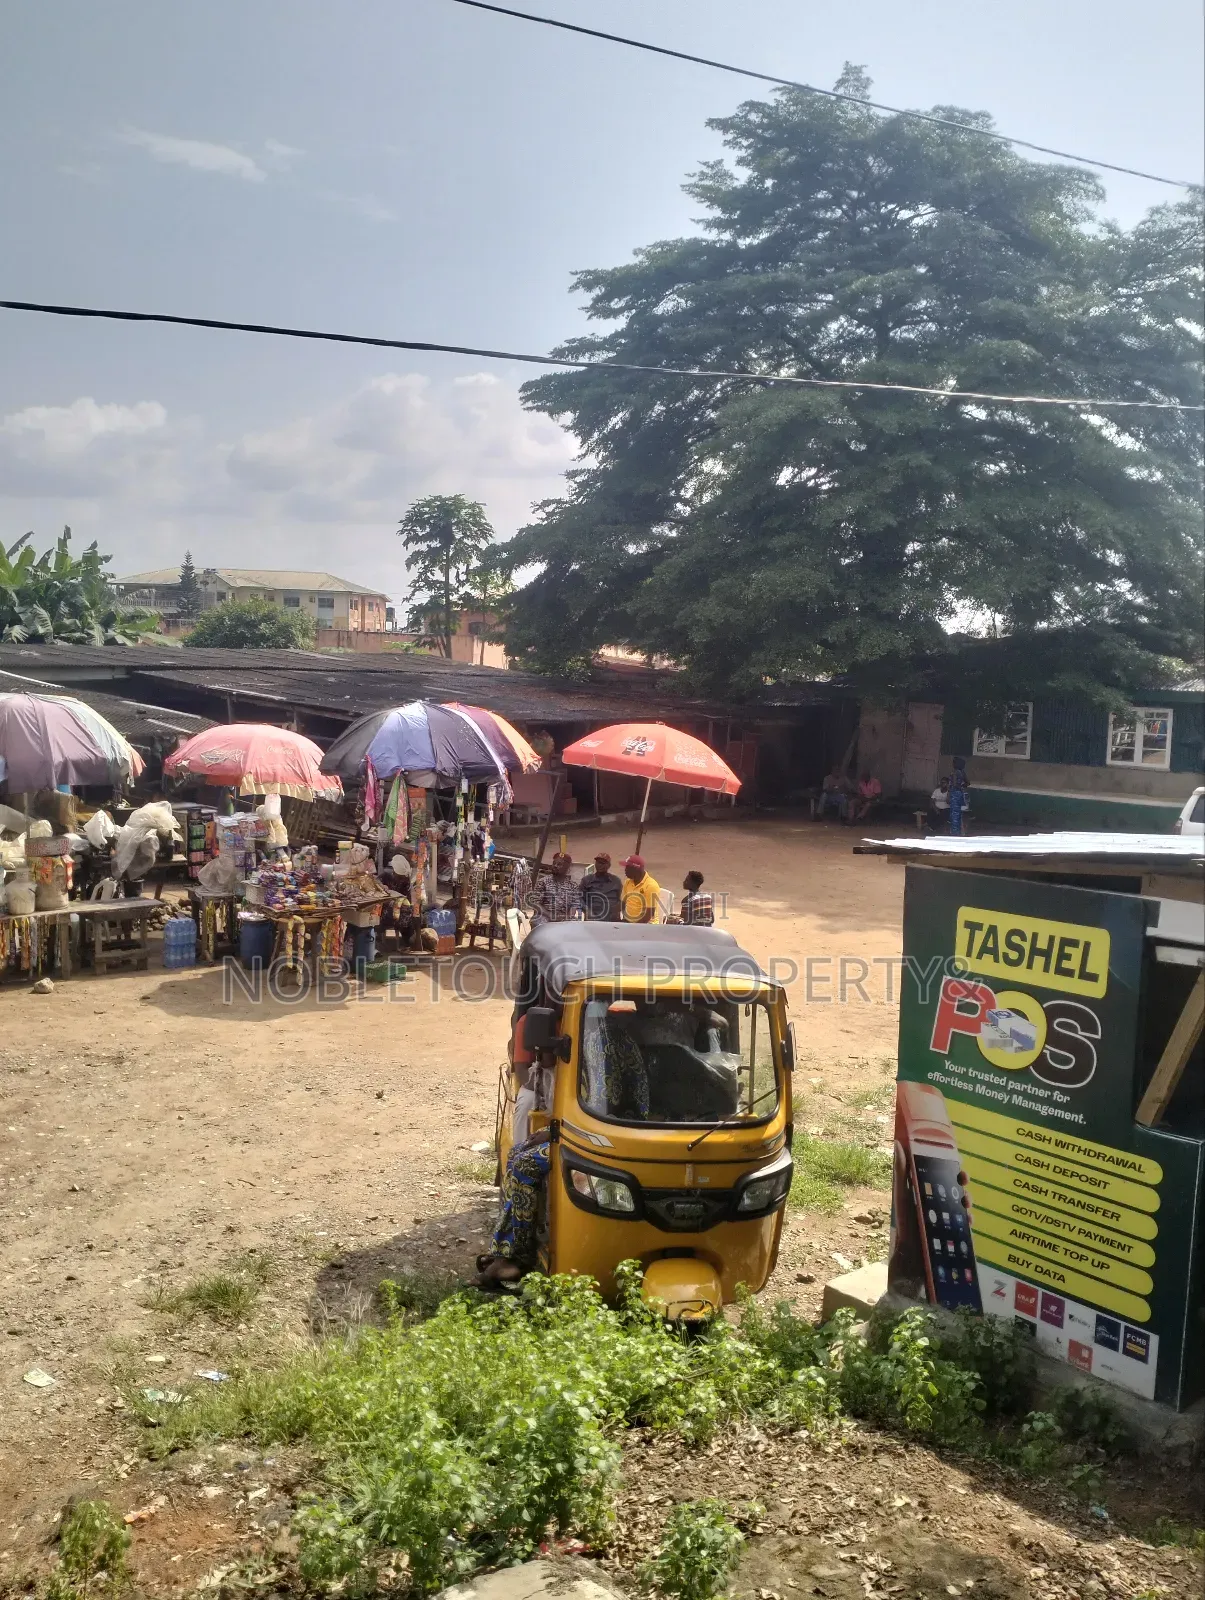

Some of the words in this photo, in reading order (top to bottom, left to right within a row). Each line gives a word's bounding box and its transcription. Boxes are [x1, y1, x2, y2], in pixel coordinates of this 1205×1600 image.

[963, 919, 1101, 983] TASHEL
[929, 974, 1102, 1089] POS
[927, 1071, 974, 1093] effortless
[975, 1083, 1010, 1106] Money
[1011, 1094, 1087, 1125] Management.
[944, 1059, 967, 1075] Your
[968, 1066, 1007, 1087] trusted
[1008, 1080, 1051, 1100] partner
[1052, 1090, 1070, 1104] for
[1014, 1153, 1050, 1171] CASH
[1052, 1163, 1111, 1190] DEPOSIT
[1016, 1127, 1052, 1146] CASH
[1053, 1138, 1147, 1175] WITHDRAWAL
[1012, 1178, 1049, 1196] CASH
[1050, 1190, 1121, 1222] TRANSFER
[1009, 1228, 1061, 1253] AIRTIME
[1062, 1246, 1089, 1263] TOP
[1090, 1256, 1111, 1272] UP
[1011, 1203, 1077, 1233] GOTV/DSTV
[1077, 1226, 1134, 1254] PAYMENT
[1007, 1253, 1032, 1269] BUY
[1034, 1264, 1066, 1283] DATA
[1126, 1332, 1147, 1346] FCMB
